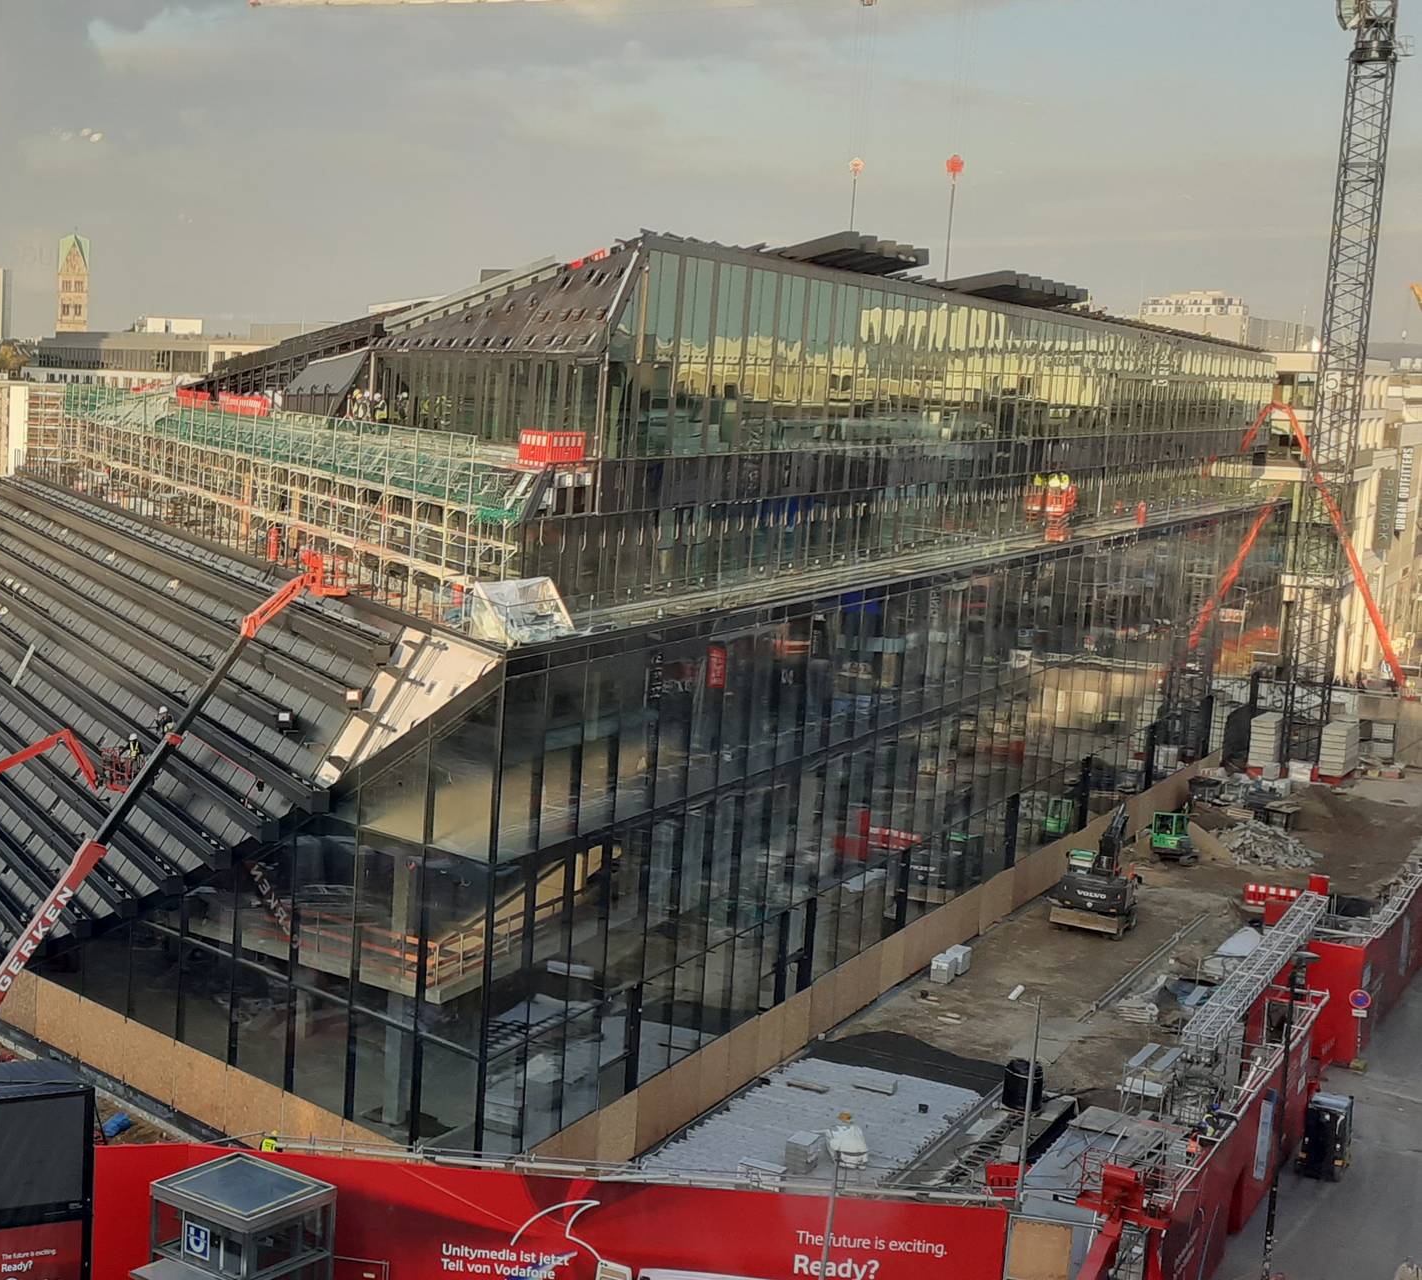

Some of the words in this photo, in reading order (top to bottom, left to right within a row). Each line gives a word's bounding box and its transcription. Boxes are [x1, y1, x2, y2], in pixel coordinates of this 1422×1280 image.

[1325, 372, 1339, 391] 5
[1398, 447, 1414, 499] OUTFITTERS
[1378, 478, 1395, 542] PRIMARK
[1394, 501, 1408, 531] URBAN
[1076, 889, 1107, 899] VOLVO
[189, 1226, 206, 1253] U
[796, 1230, 824, 1246] The
[828, 1232, 871, 1249] future
[874, 1236, 886, 1250] is
[888, 1239, 948, 1258] exciting.
[1, 1260, 34, 1273] Ready?
[442, 1243, 517, 1261] Unitymedia
[520, 1249, 536, 1264] ist
[538, 1252, 569, 1267] jetzt
[793, 1253, 880, 1280] Ready?
[441, 1258, 463, 1272] Teil
[467, 1263, 491, 1274] von
[494, 1263, 555, 1280] Vodafone
